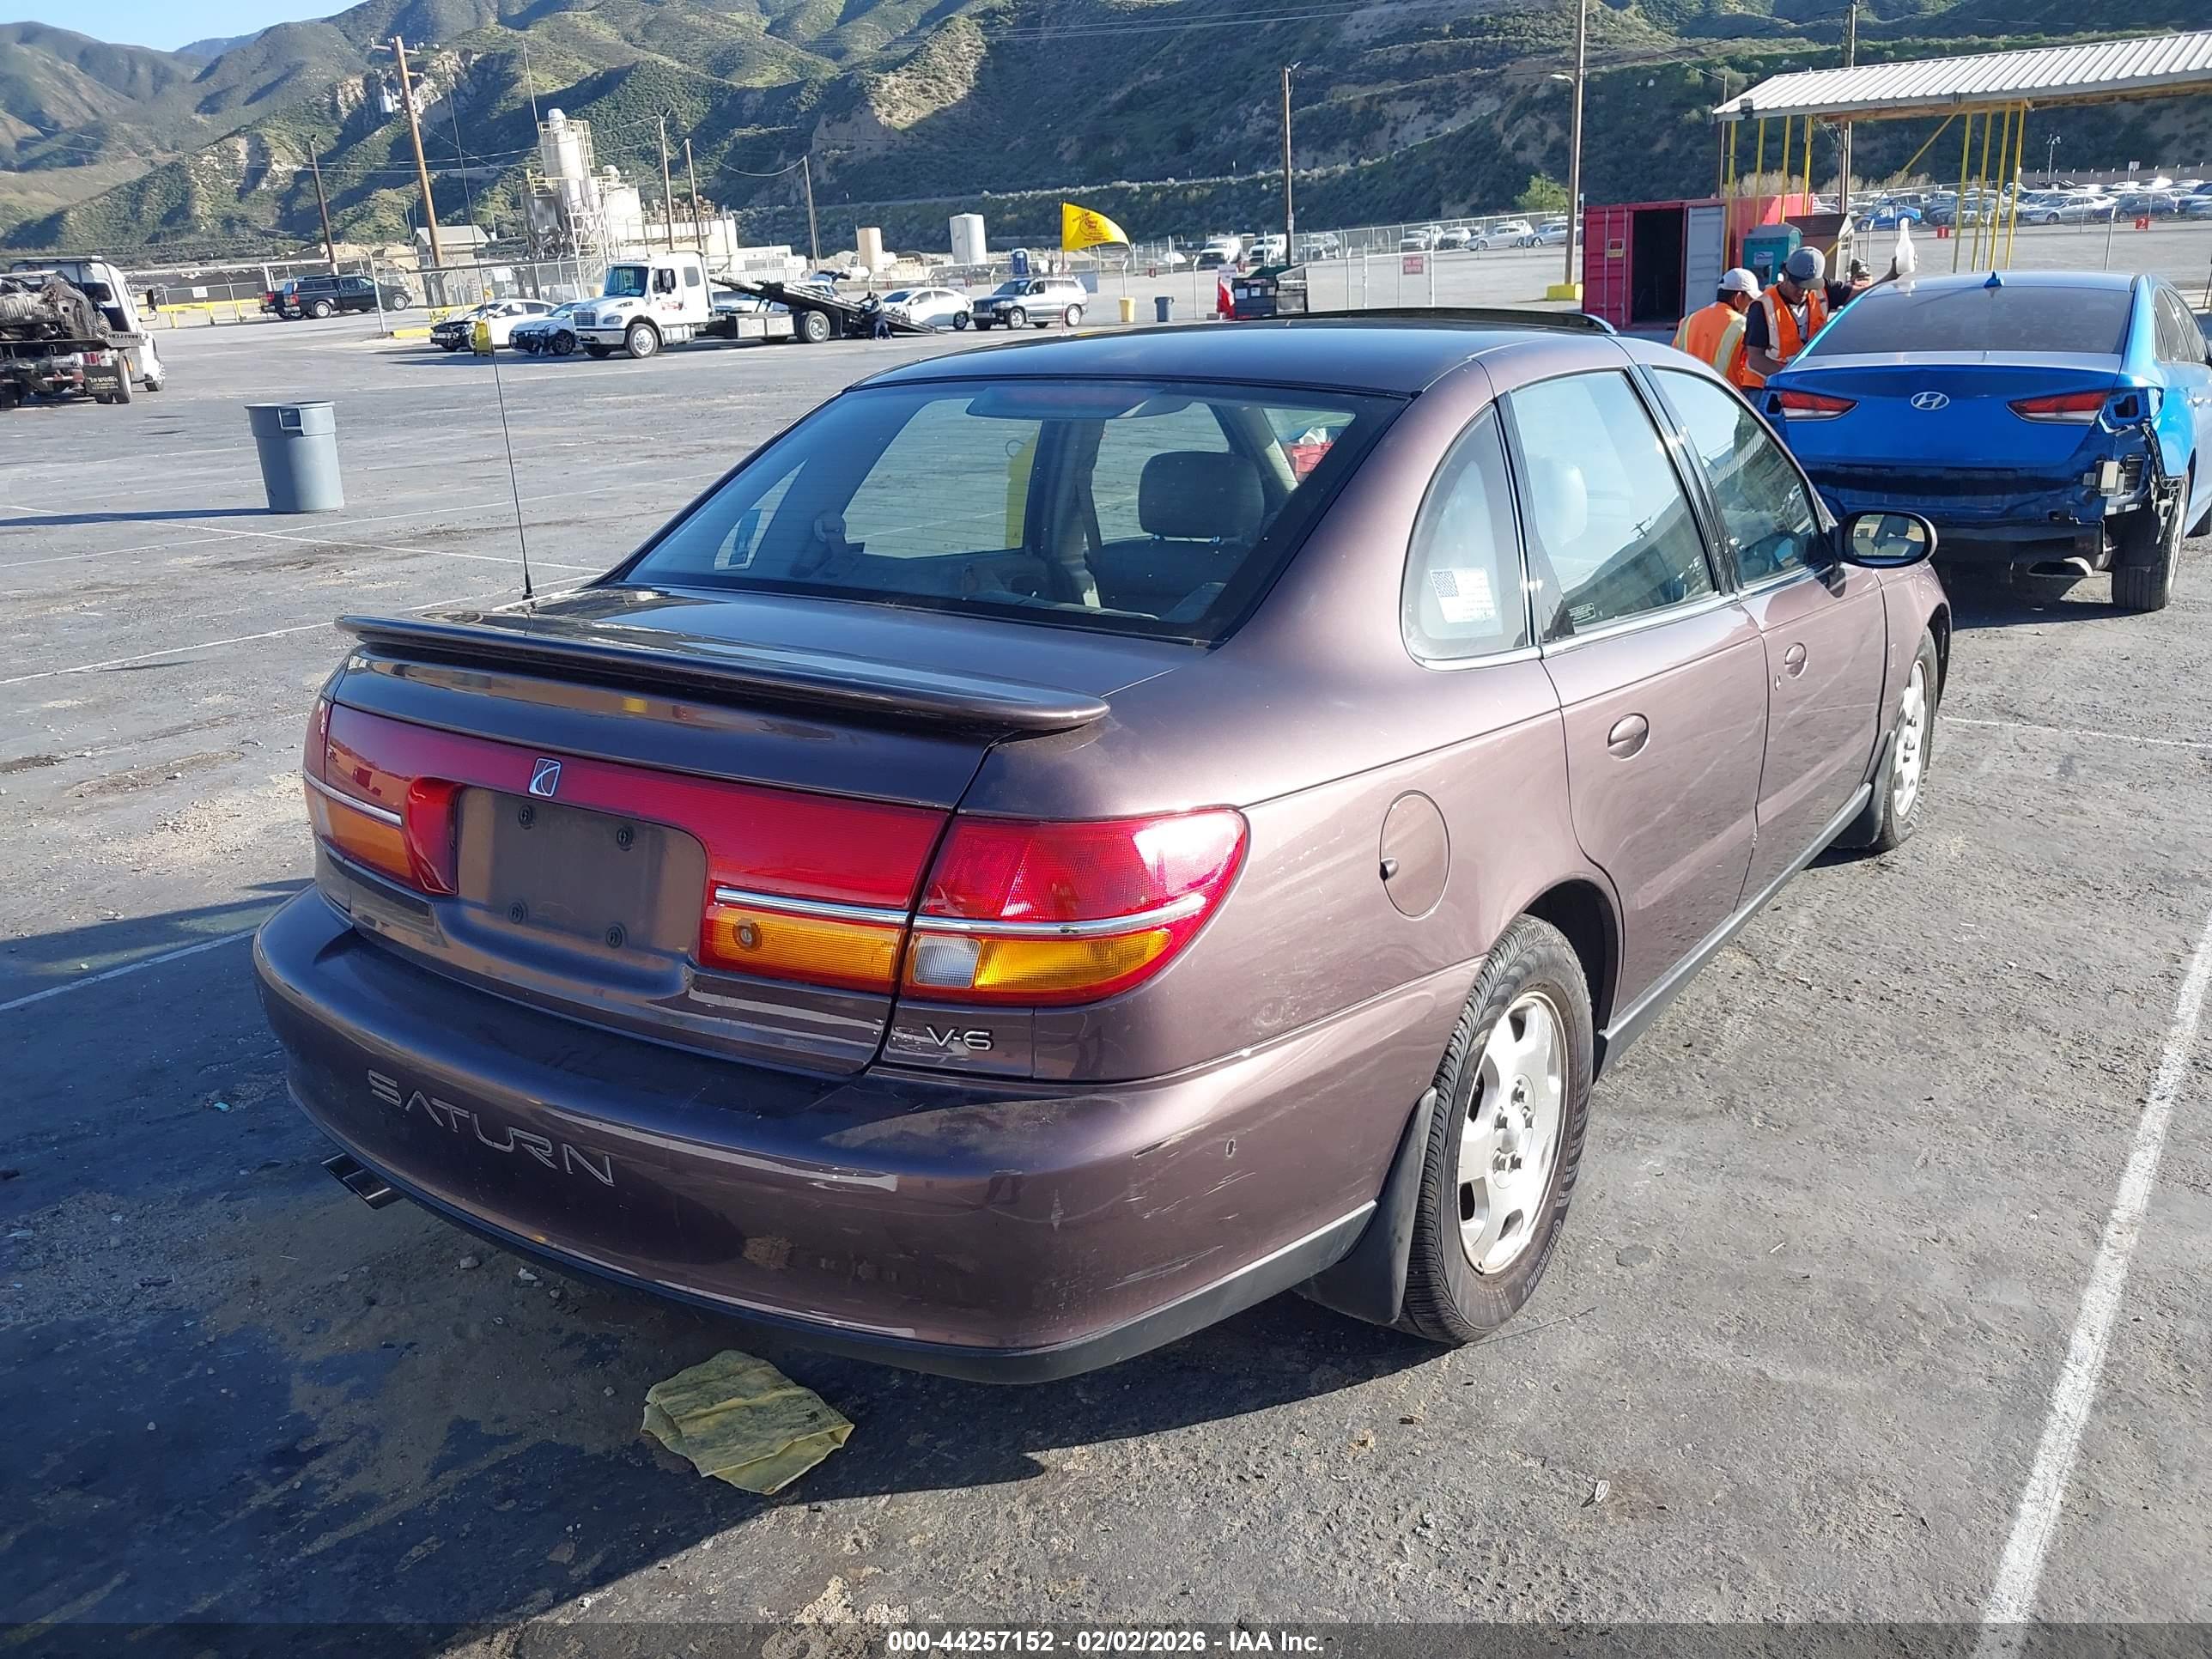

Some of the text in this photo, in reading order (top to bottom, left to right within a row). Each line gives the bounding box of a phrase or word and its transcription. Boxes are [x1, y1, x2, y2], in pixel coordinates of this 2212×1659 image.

[2138, 218, 2146, 228] 2
[927, 1024, 993, 1051] V-6
[368, 1069, 615, 1187] SATURN
